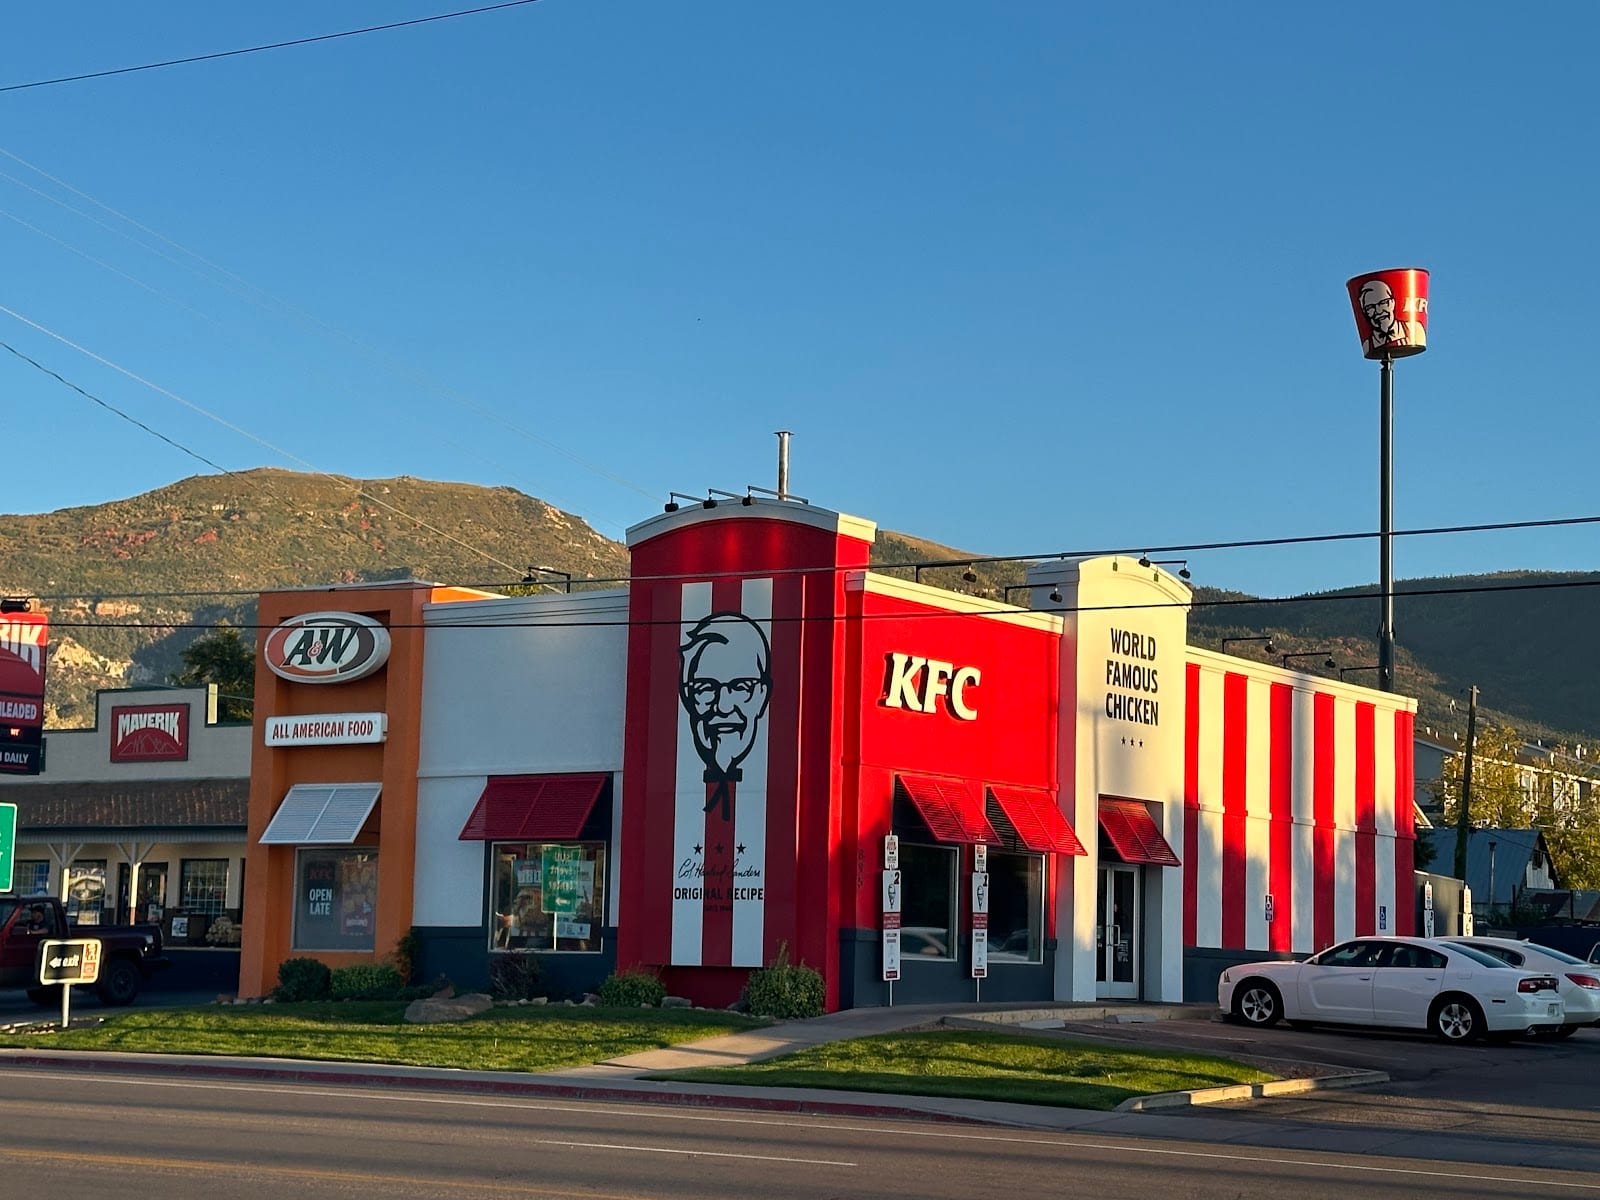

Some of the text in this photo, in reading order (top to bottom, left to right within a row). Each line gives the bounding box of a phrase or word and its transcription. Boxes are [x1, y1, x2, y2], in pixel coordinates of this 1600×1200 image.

[280, 626, 358, 666] A&W
[1110, 627, 1156, 661] WORLD
[1106, 659, 1158, 693] FAMOUS
[885, 652, 982, 721] KFC
[0, 701, 37, 719] LEADED
[1105, 692, 1158, 726] CHICKEN
[117, 712, 180, 747] MAVERIK
[272, 719, 373, 740] ALL AMERICAN FOOD
[4, 751, 29, 764] DAILY
[894, 872, 900, 885] 2
[982, 874, 988, 887] 1
[309, 889, 332, 901] OPEN
[674, 887, 764, 900] ORIGINAL RECIPE
[310, 903, 331, 915] LATE
